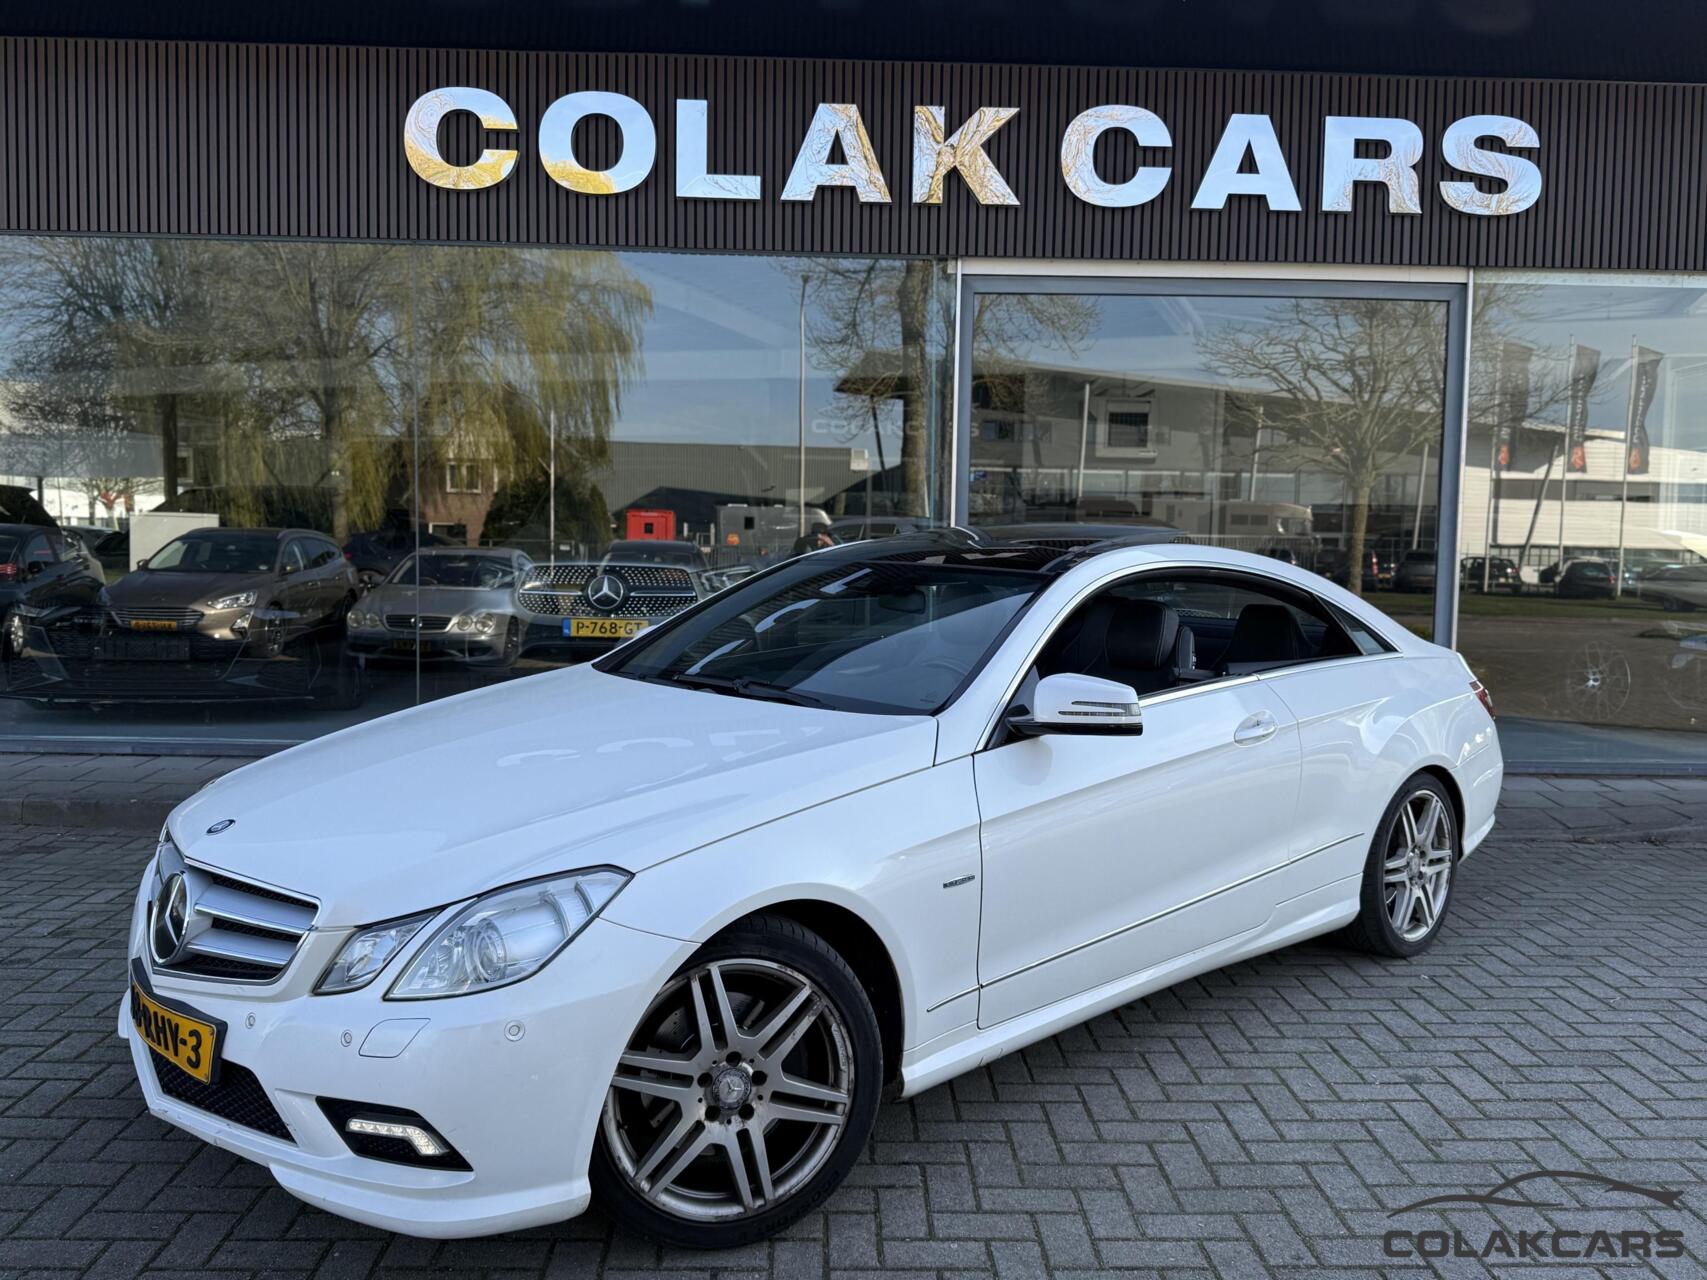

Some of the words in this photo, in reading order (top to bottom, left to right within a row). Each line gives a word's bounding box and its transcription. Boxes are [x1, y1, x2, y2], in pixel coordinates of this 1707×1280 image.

[403, 86, 1020, 206] COLAK
[1061, 104, 1544, 217] CARS
[576, 621, 643, 635] P-768-GT
[131, 986, 203, 1070] -RHV-3
